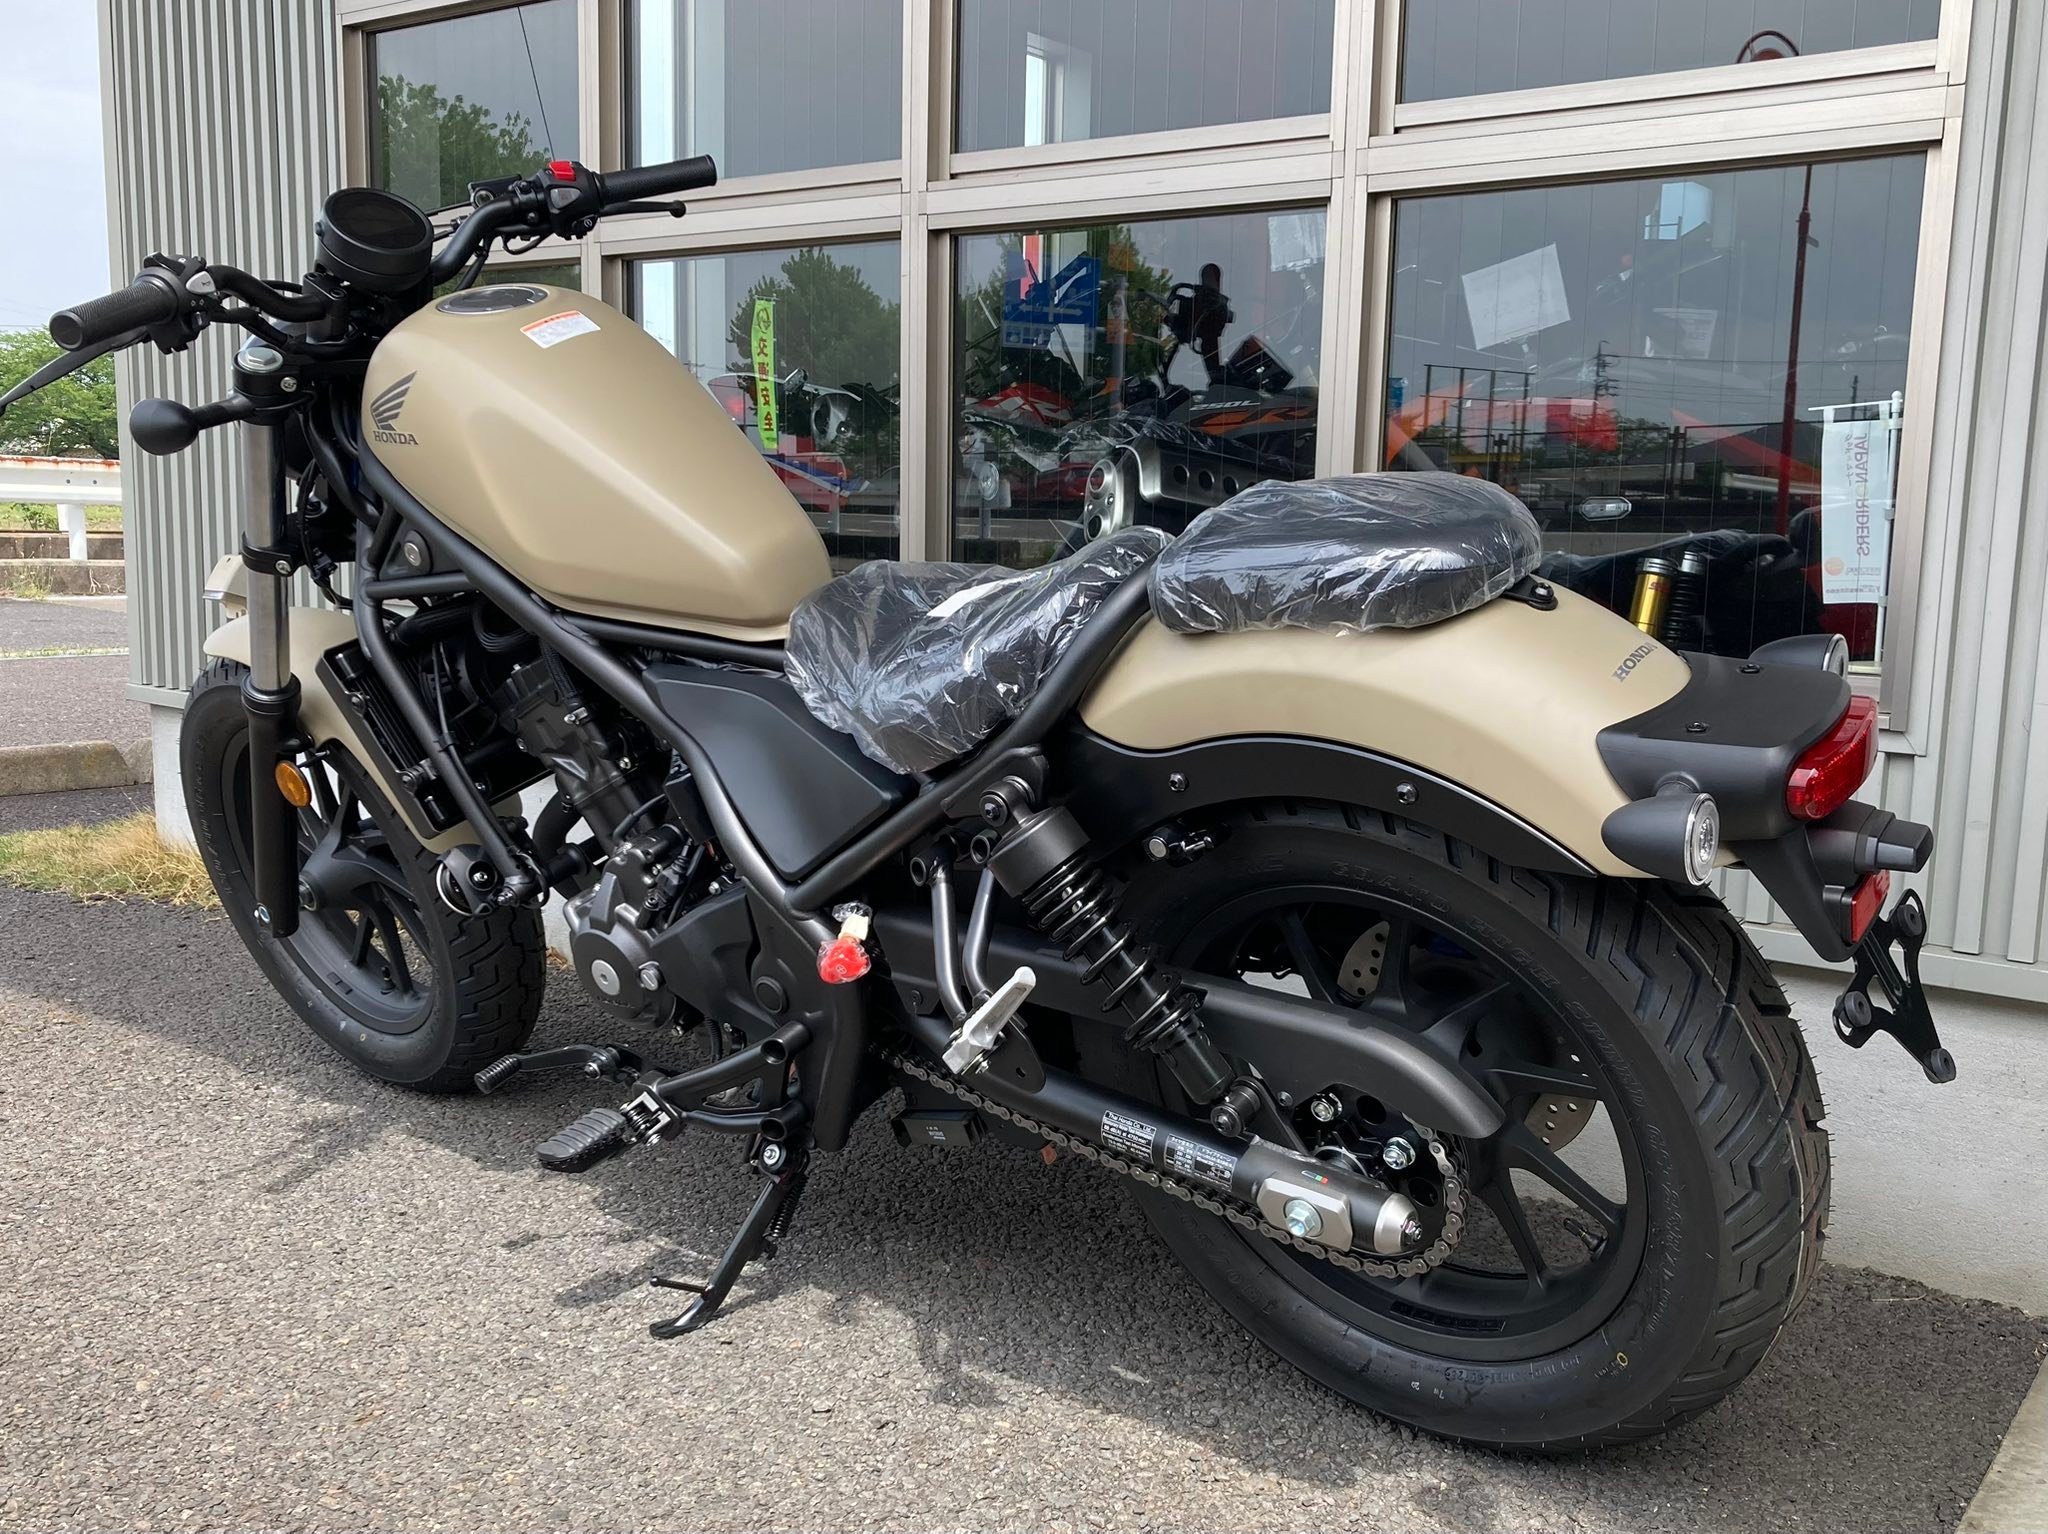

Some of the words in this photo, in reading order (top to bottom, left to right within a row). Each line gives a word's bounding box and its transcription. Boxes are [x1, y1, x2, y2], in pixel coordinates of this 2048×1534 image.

[1189, 400, 1261, 411] 250L
[372, 430, 419, 446] HONDA
[1611, 641, 1658, 683] HONDA
[1118, 1116, 1134, 1127] Honda
